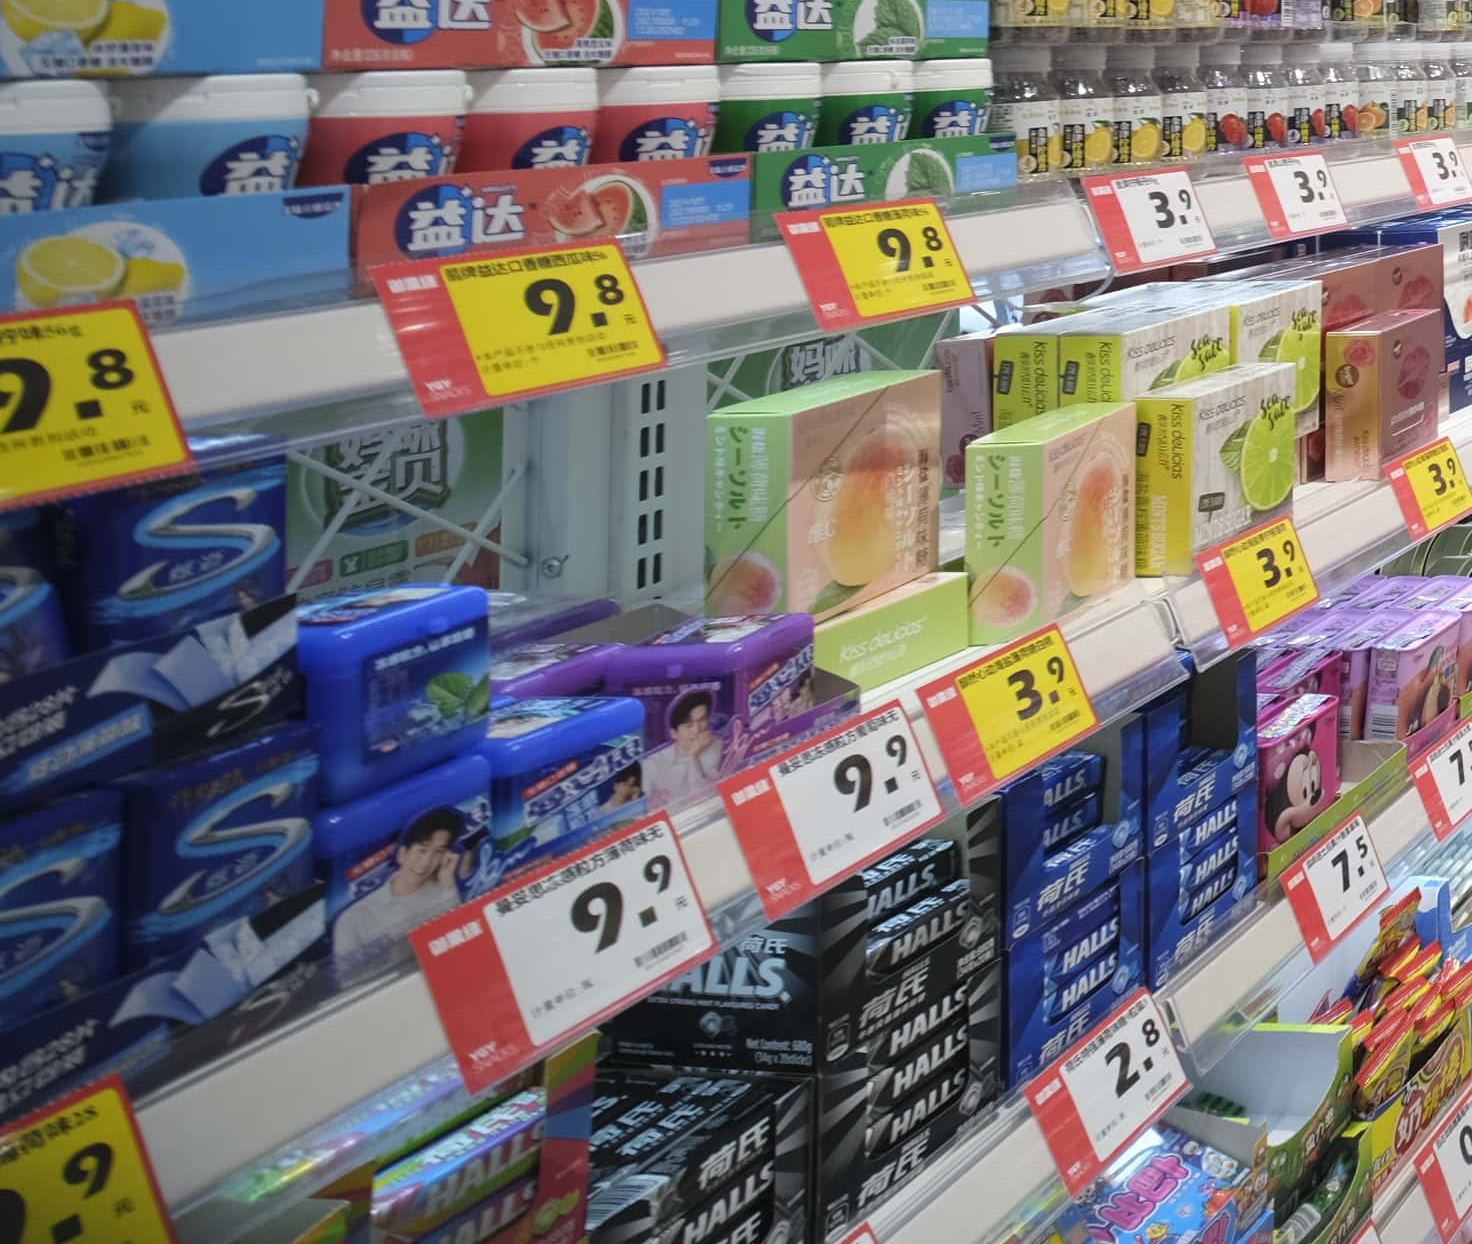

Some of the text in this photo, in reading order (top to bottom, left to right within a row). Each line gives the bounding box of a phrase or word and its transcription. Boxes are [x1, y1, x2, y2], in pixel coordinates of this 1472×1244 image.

[787, 170, 866, 212] 益达
[1293, 169, 1328, 203] 3.9
[1435, 150, 1459, 182] 3.9
[407, 194, 525, 253] 益达
[1149, 189, 1192, 229] 3.9
[877, 226, 944, 273] 9.8
[524, 274, 625, 335] 9.8
[1429, 458, 1457, 497] 3.9
[1257, 540, 1296, 590] 3.9
[1007, 657, 1064, 721] 3.9
[833, 734, 907, 813] 9.9
[1173, 778, 1216, 823] 荷氏
[1195, 794, 1238, 845] HALLS
[1038, 863, 1089, 910] 荷氏
[1195, 835, 1239, 884] HALLS
[1331, 833, 1369, 894] 7.5
[570, 854, 673, 954] 9.9
[1190, 867, 1235, 916] HALLS
[741, 933, 787, 956] 荷氏
[891, 898, 970, 966] HALLS
[1062, 917, 1119, 975] HALLS
[859, 968, 930, 1030] 荷氏
[1061, 955, 1118, 1011] HALLS
[890, 981, 969, 1057] HALLS
[892, 1023, 969, 1101] HALLS
[1105, 1019, 1161, 1100] 2.8
[890, 1068, 965, 1147] HALLS
